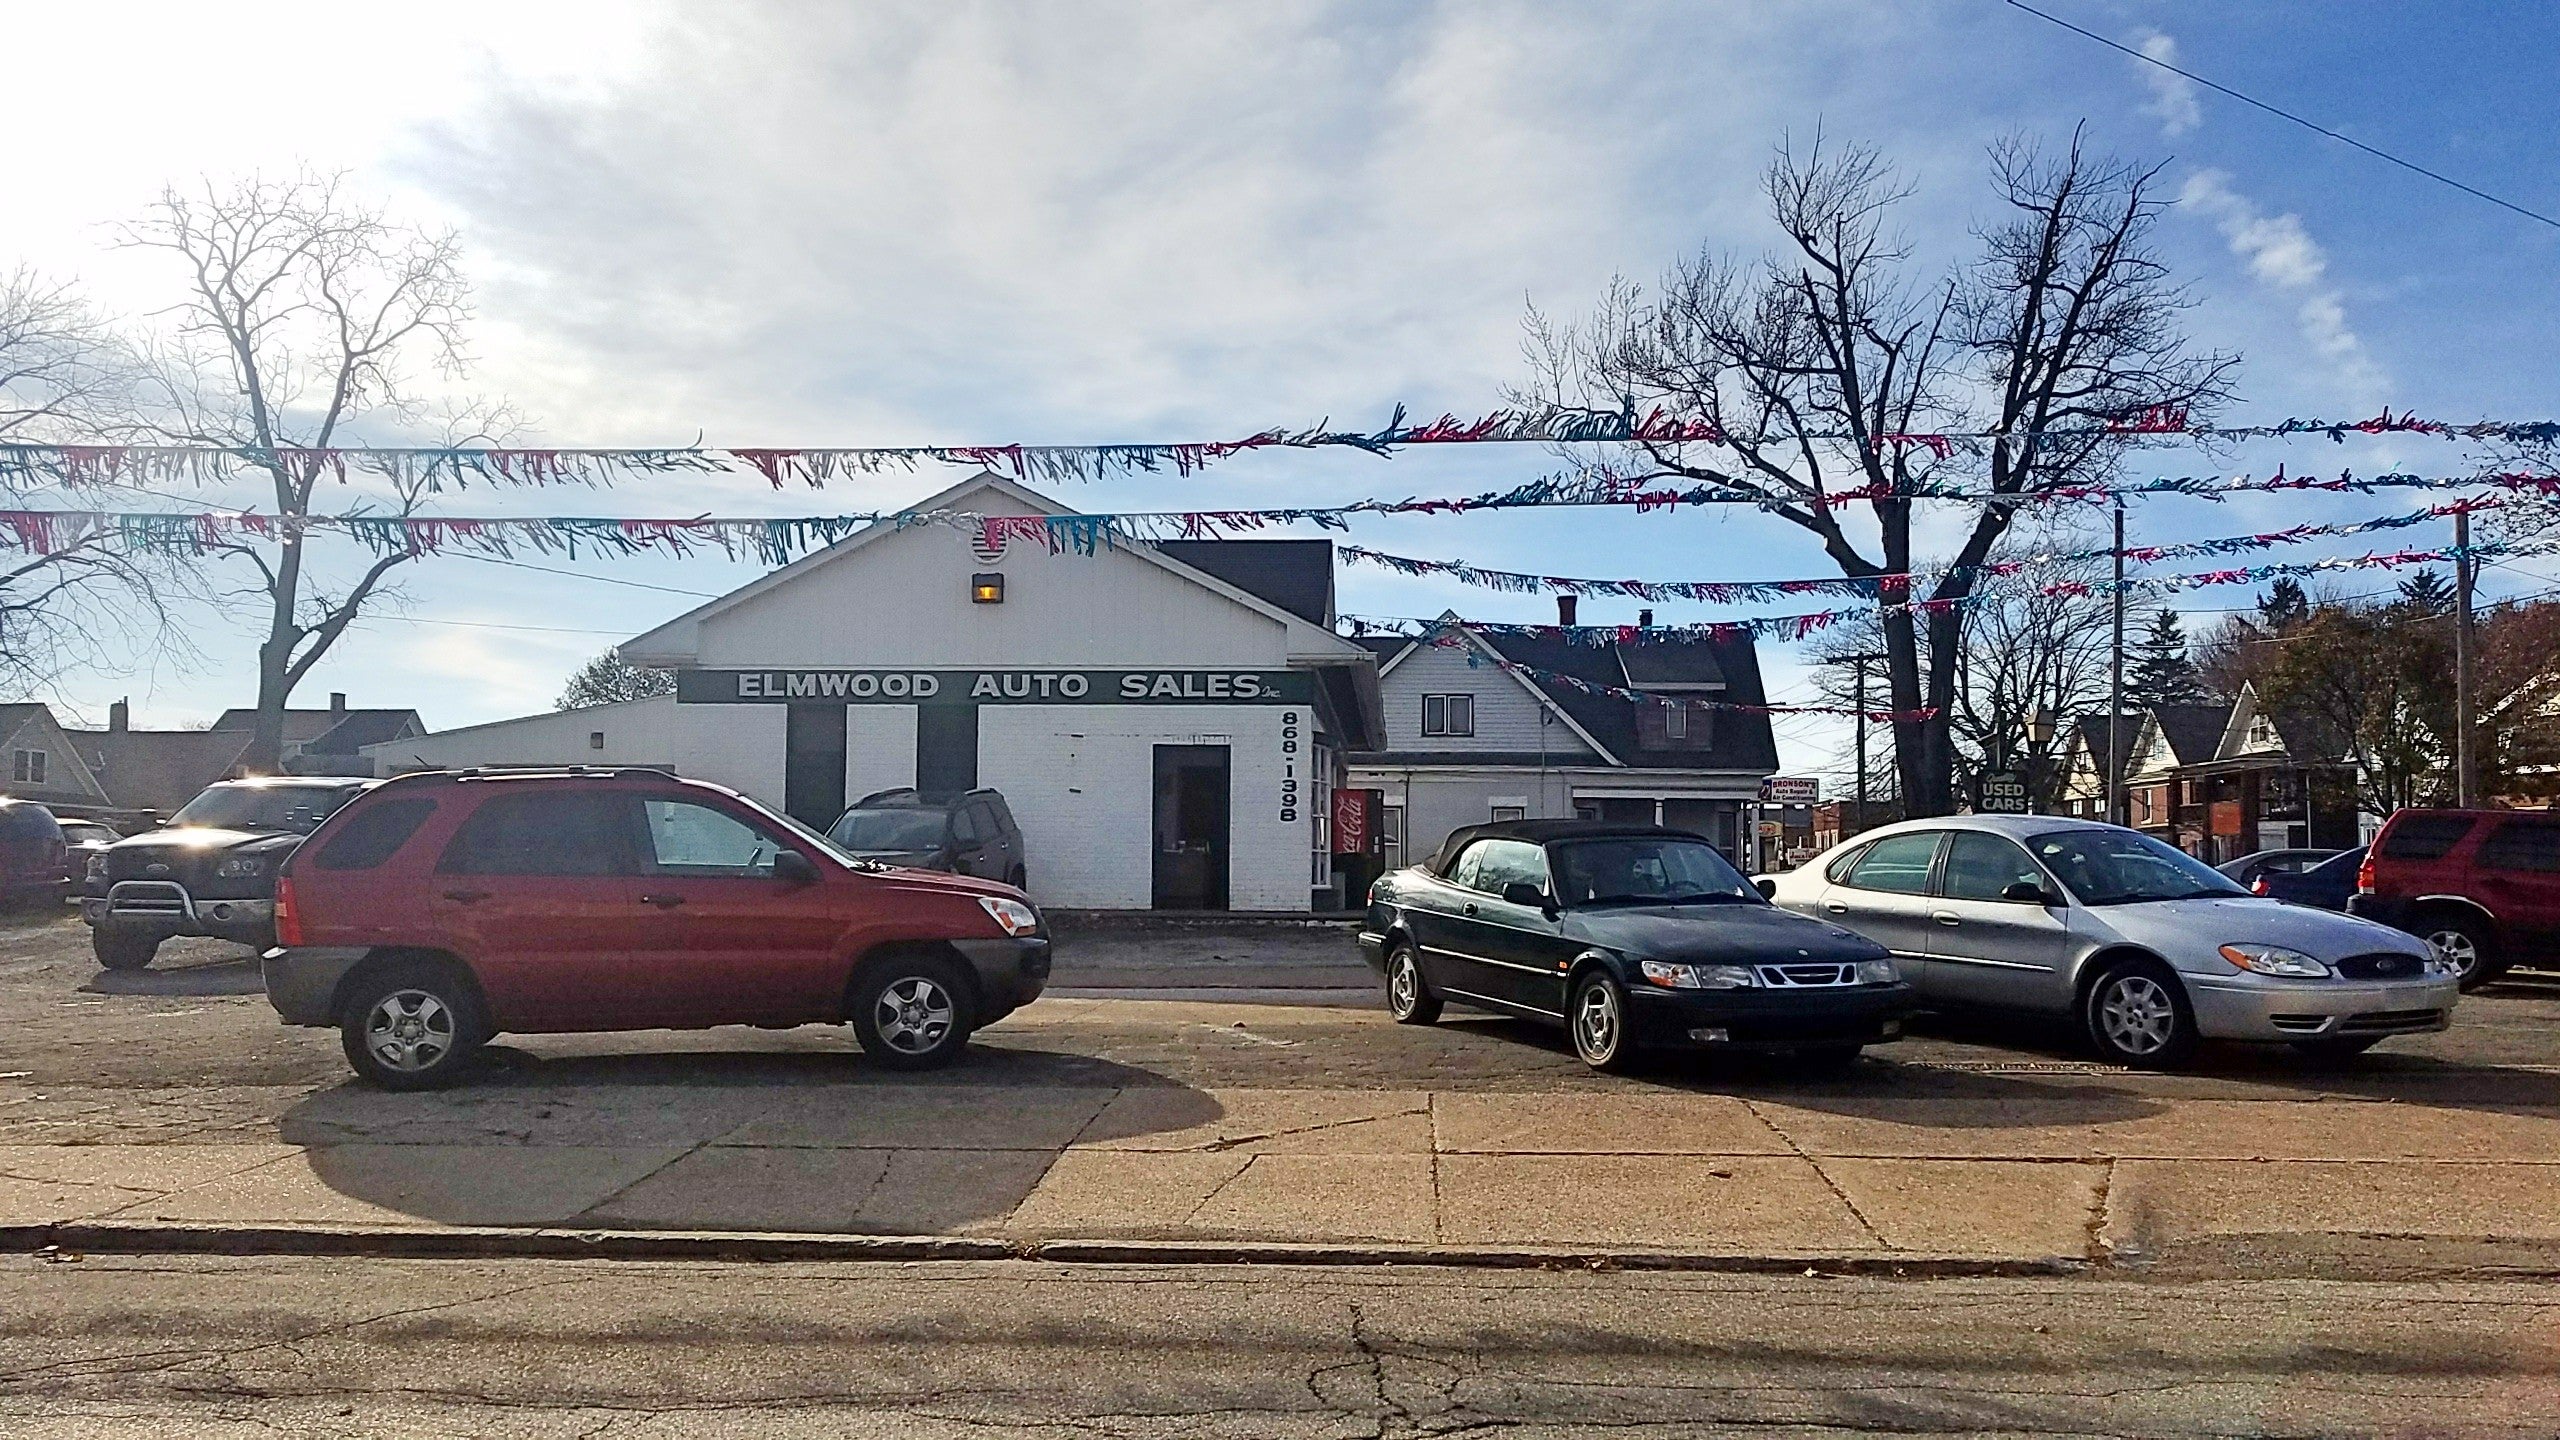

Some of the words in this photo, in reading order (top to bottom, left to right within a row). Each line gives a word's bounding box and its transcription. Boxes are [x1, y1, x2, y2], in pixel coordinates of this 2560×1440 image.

[738, 673, 940, 698] ELMWOOD
[970, 673, 1089, 698] AUTO
[1119, 673, 1261, 698] SALES
[1280, 711, 1298, 822] 868-1398
[1772, 780, 1816, 789] BRONSON'S
[1982, 783, 2025, 796] USED
[1982, 797, 2025, 811] CARS
